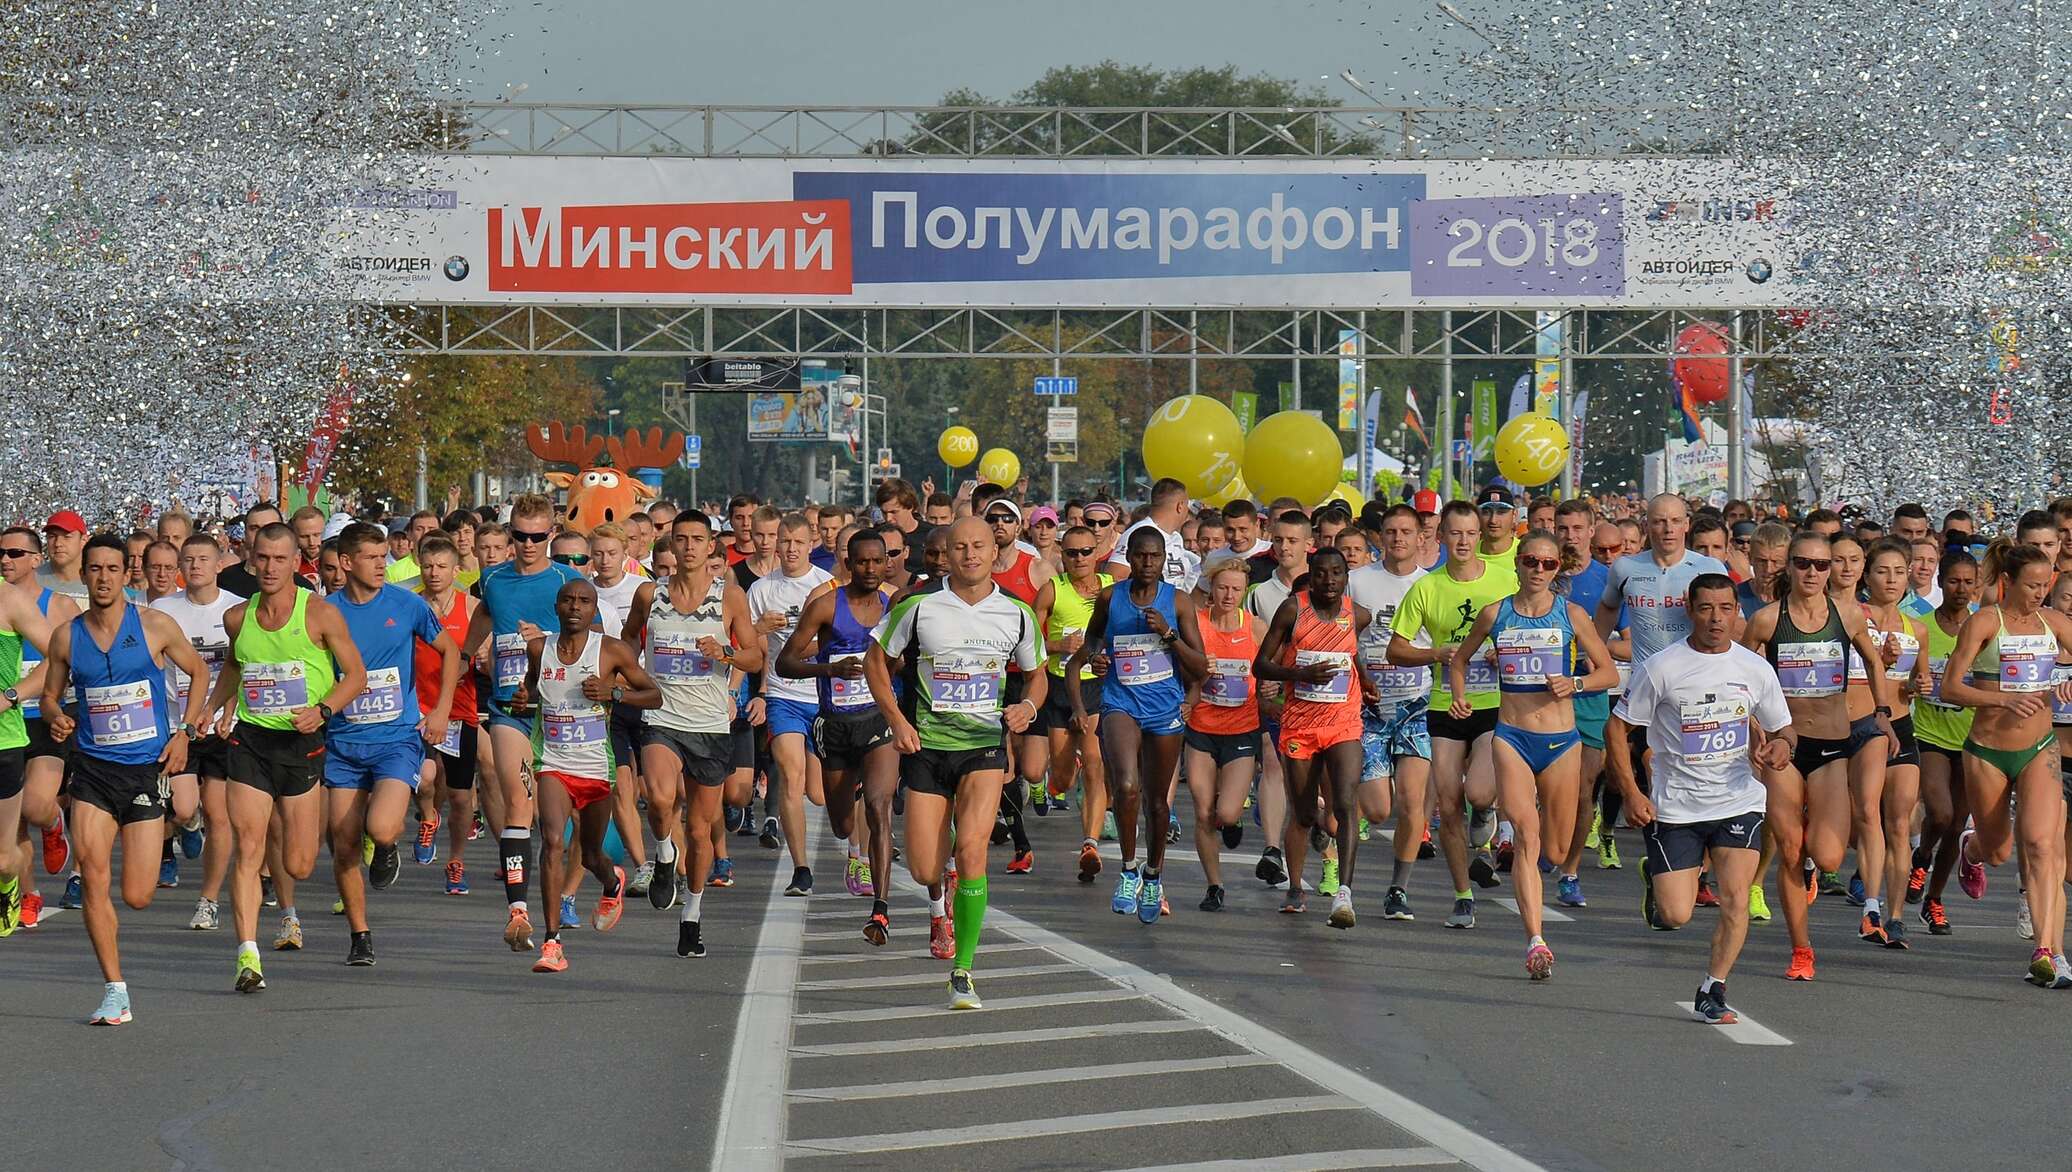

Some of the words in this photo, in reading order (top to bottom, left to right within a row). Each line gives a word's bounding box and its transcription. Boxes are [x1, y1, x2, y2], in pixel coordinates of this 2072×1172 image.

[871, 191, 1400, 265] Полумарафон
[1446, 217, 1600, 268] 2018
[1642, 260, 1734, 276] АВТОИДЕЯ
[1714, 276, 1734, 285] BMW
[1626, 595, 1655, 608] Alfa
[670, 657, 694, 675] 58
[1139, 659, 1150, 673] 5
[1519, 656, 1543, 673] 10
[2027, 664, 2039, 681] 3
[1373, 672, 1416, 687] 2532
[1466, 668, 1491, 682] 52
[1804, 669, 1818, 686] 4
[263, 688, 287, 706] 53
[940, 682, 991, 700] 2412
[1217, 682, 1228, 697] 2
[351, 694, 395, 715] 1445
[108, 713, 133, 733] 61
[561, 725, 586, 742] 54
[1698, 730, 1737, 752] 769
